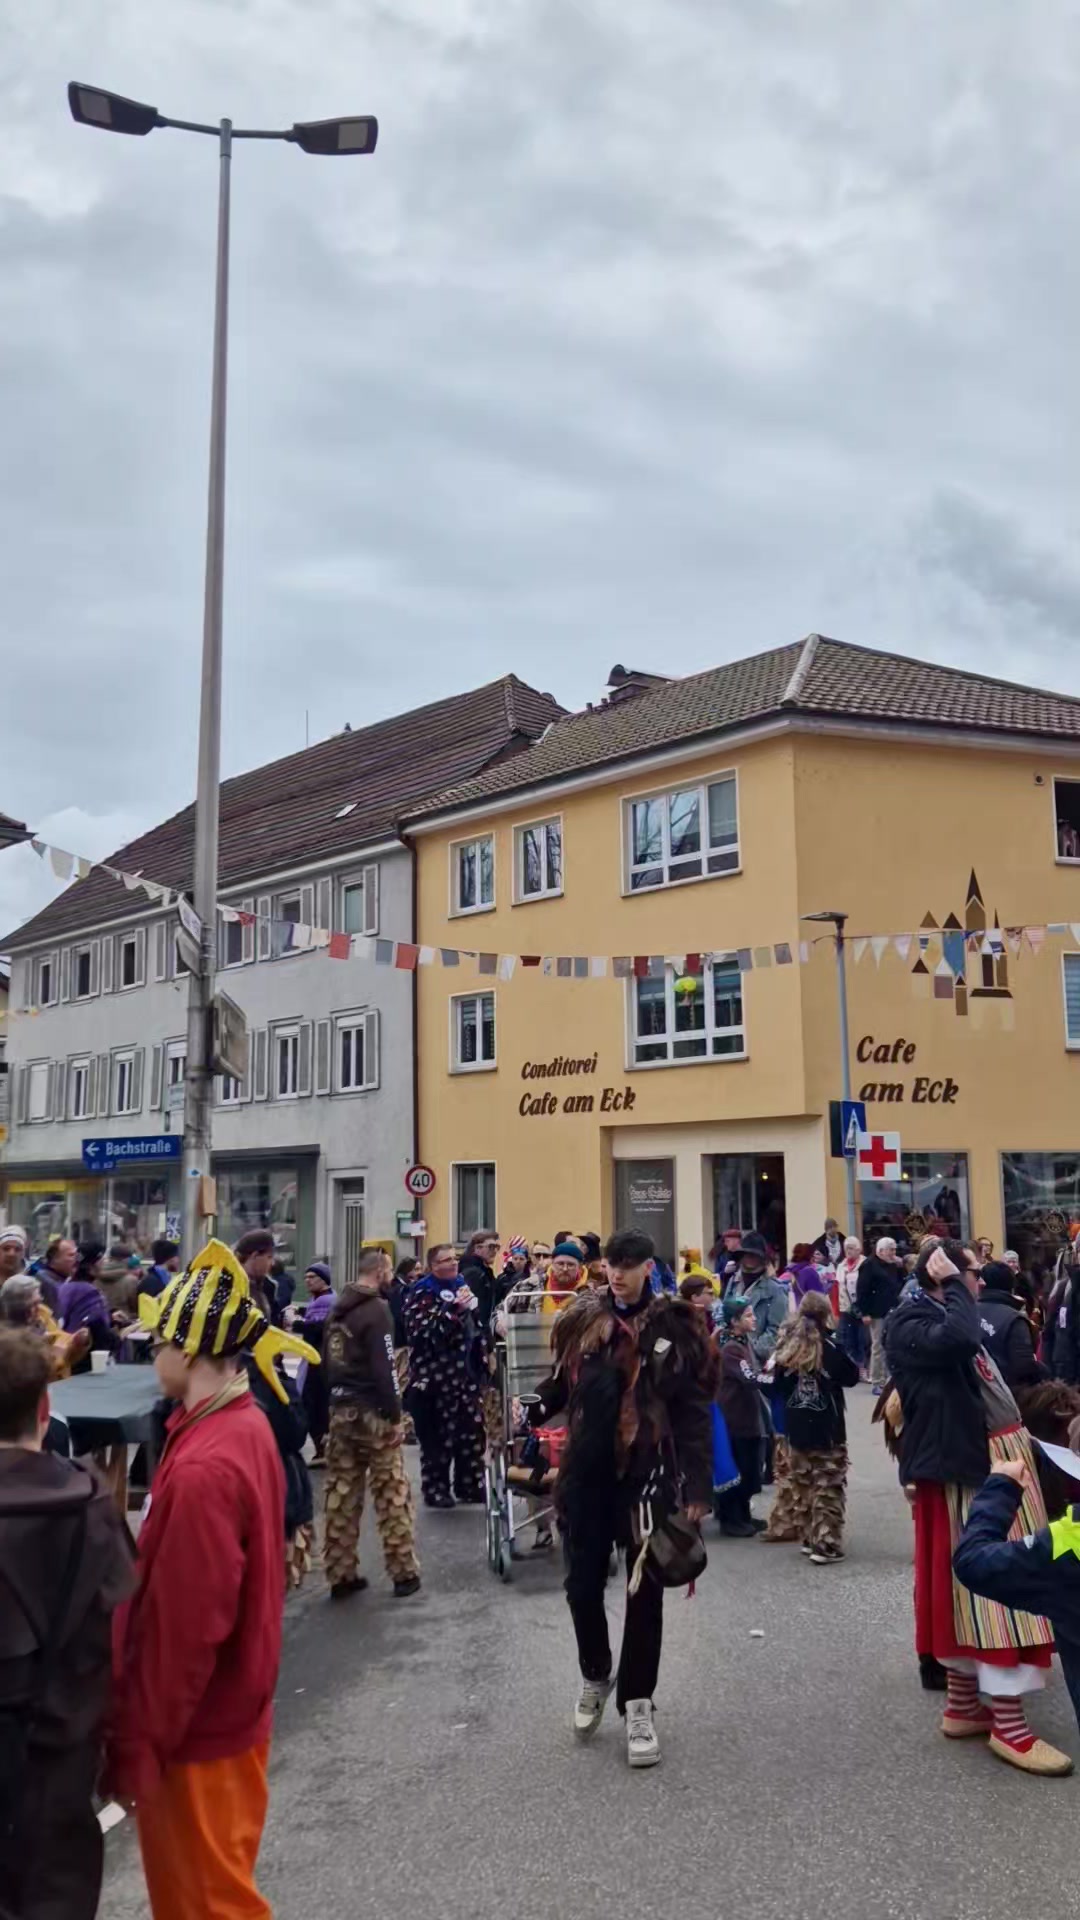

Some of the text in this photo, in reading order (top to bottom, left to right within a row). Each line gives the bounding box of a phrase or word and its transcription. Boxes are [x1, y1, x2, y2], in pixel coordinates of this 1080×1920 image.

[856, 1036, 916, 1064] Cafe
[521, 1052, 598, 1080] Conditorei
[519, 1086, 636, 1116] Cafe am Eck
[859, 1077, 959, 1104] am Eck
[105, 1139, 172, 1156] Bachstraße
[412, 1173, 430, 1188] 40
